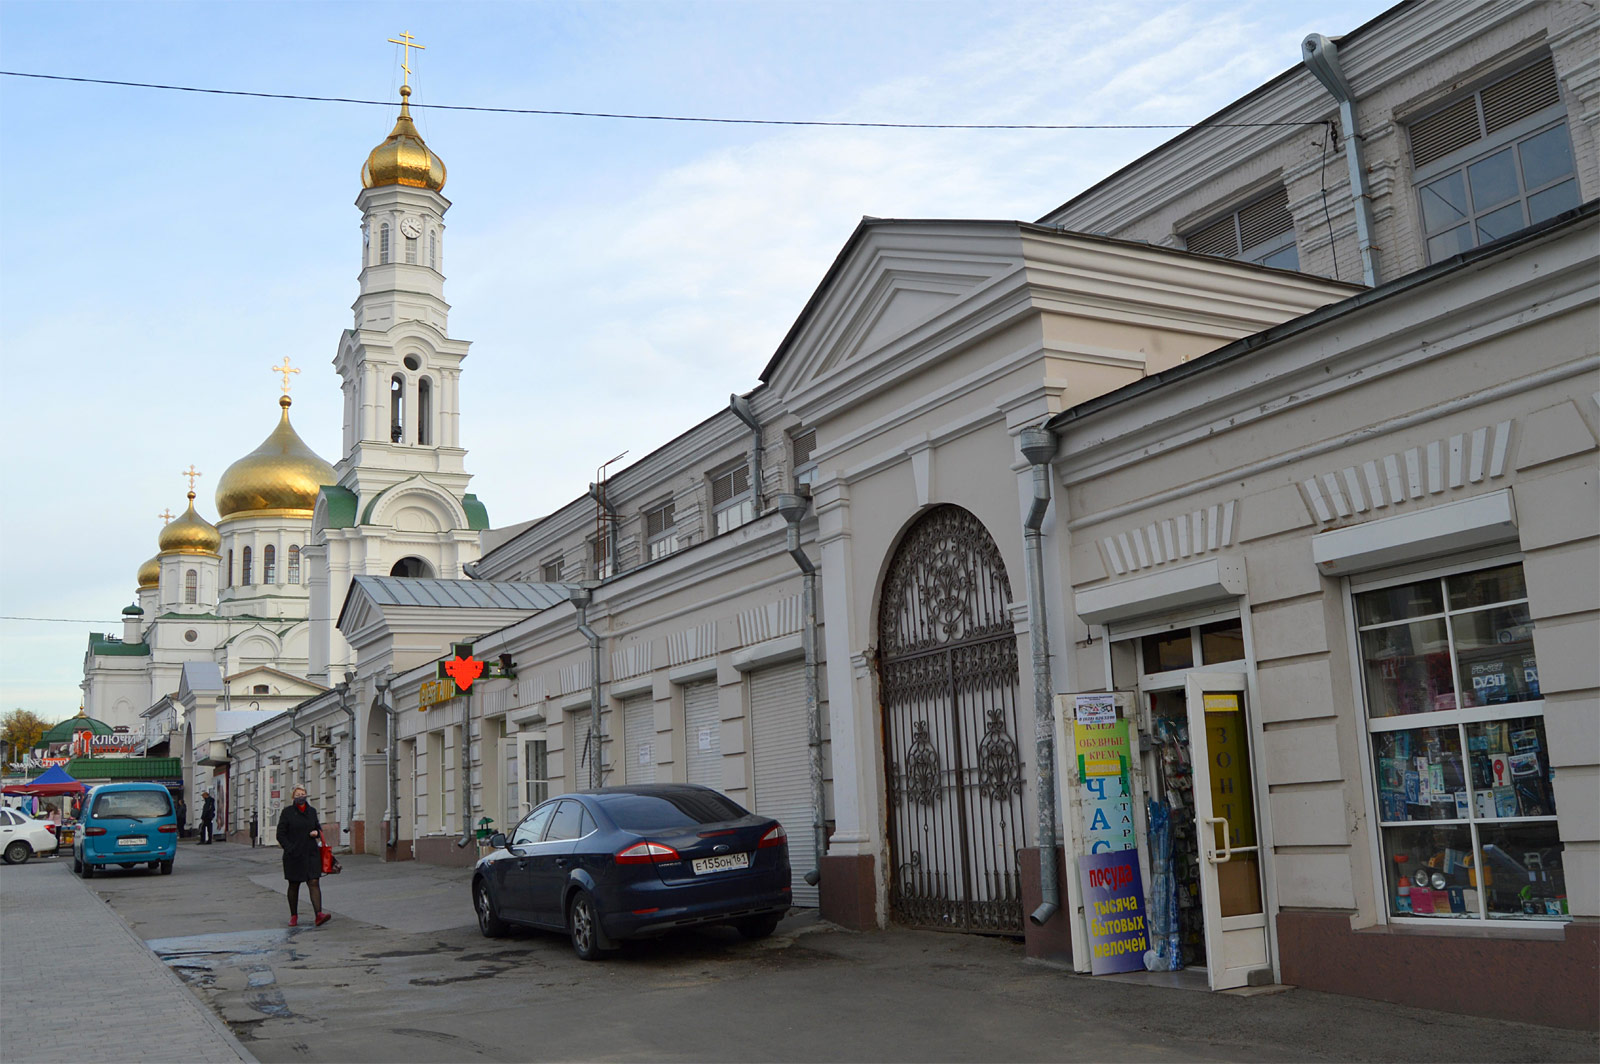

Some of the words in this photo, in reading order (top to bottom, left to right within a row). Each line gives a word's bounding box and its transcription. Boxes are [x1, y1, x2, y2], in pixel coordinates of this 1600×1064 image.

[92, 735, 136, 745] КЛЮЧИ
[1080, 736, 1125, 748] ОБУВНЫЕ
[1093, 896, 1138, 915] тысяча
[1091, 916, 1144, 937] бытовых
[1094, 932, 1146, 958] мелочей
